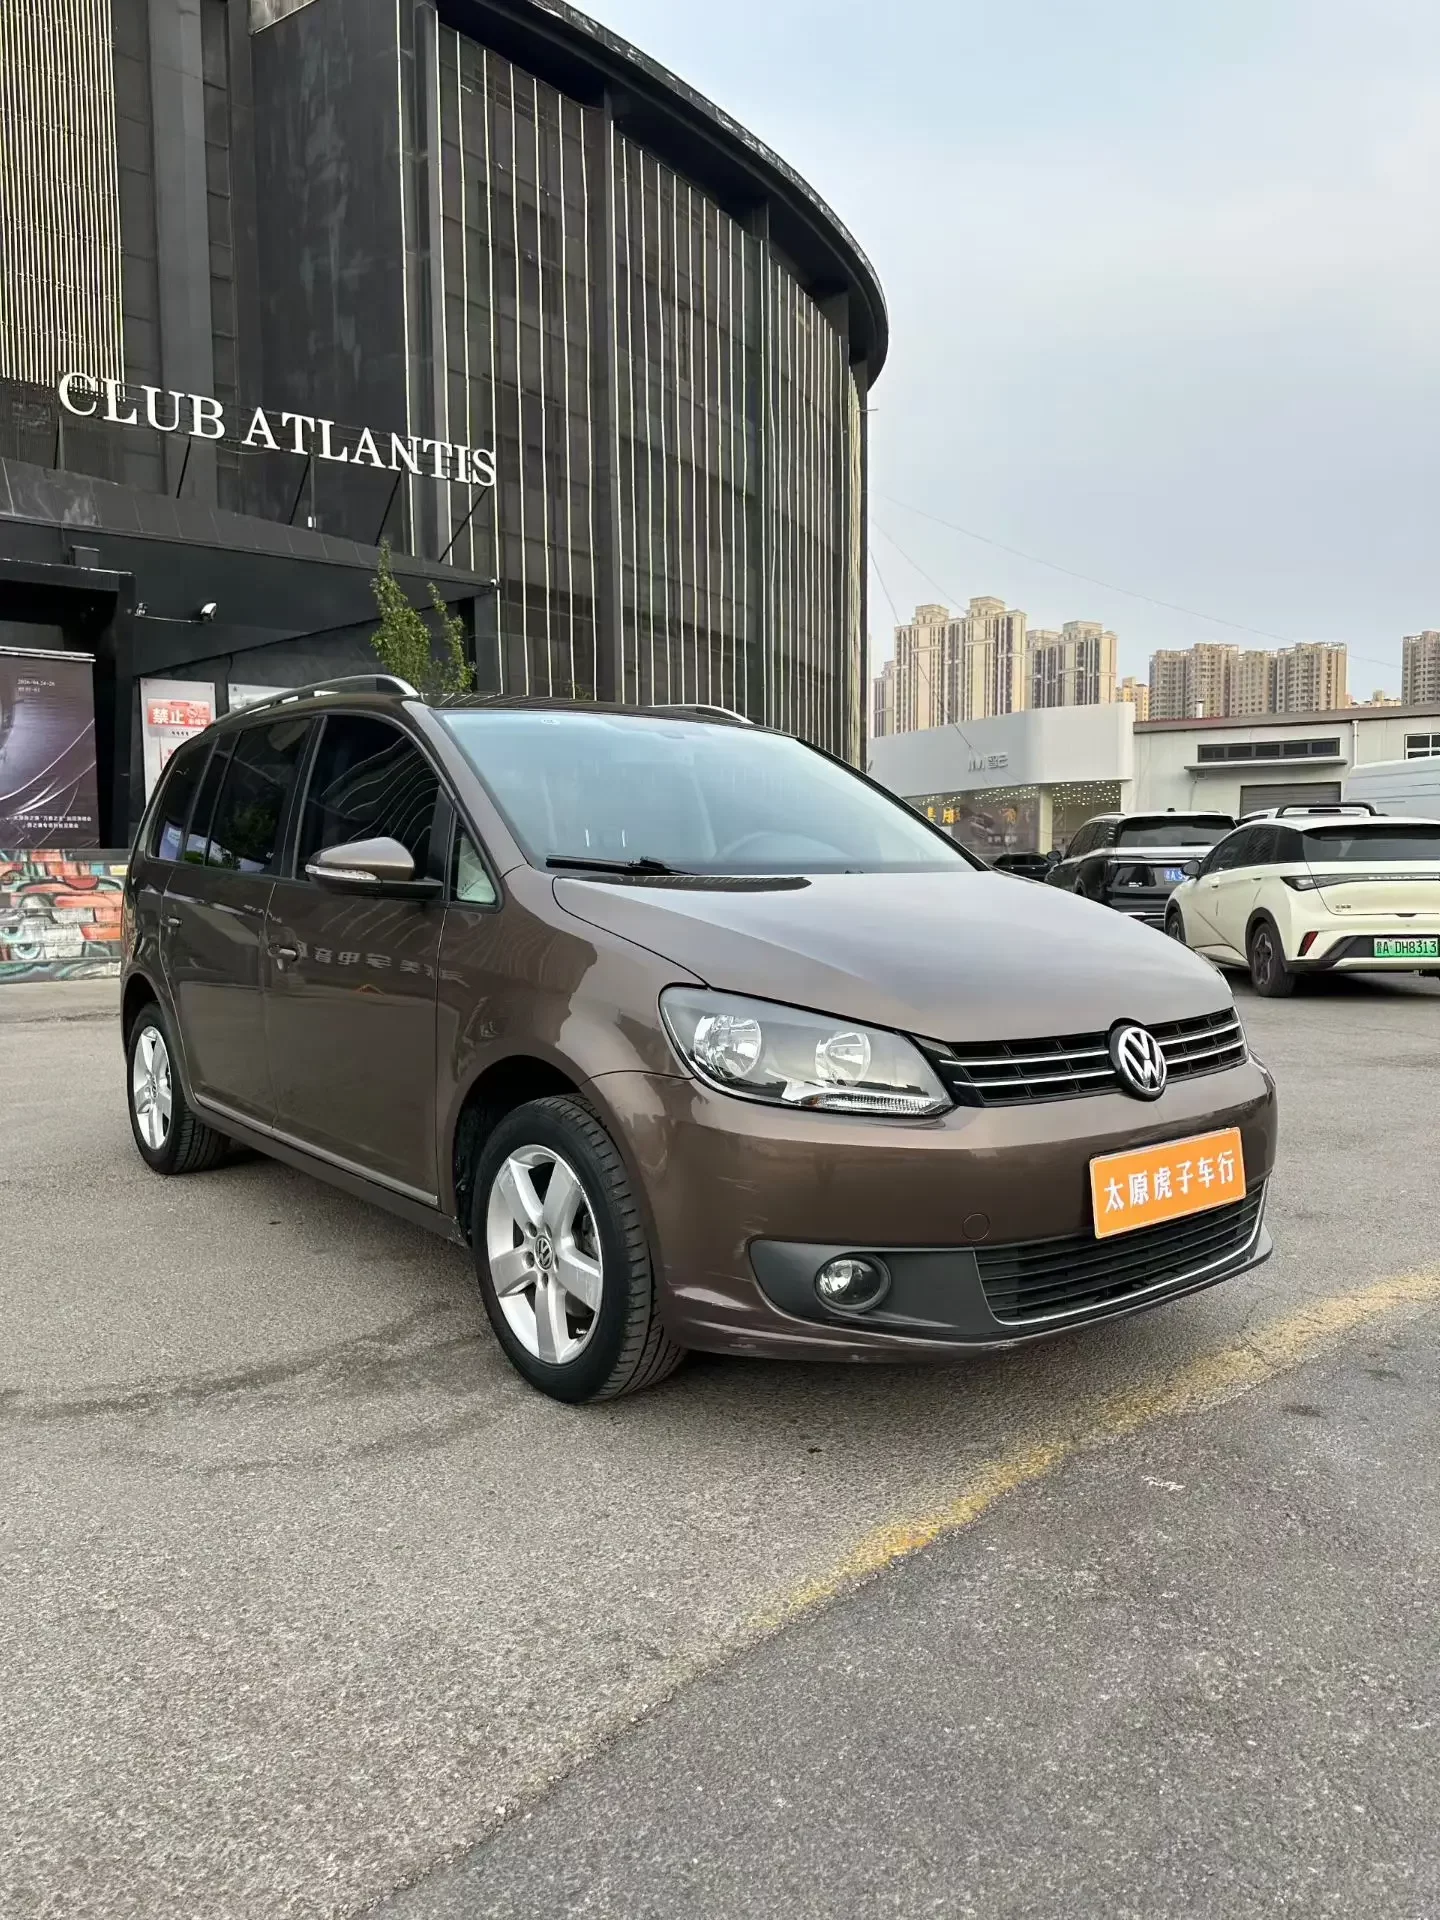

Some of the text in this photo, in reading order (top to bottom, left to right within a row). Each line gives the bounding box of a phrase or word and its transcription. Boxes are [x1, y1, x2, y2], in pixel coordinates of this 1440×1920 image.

[58, 371, 497, 487] CLUB ATLANTIS
[152, 707, 186, 725] 禁止
[1103, 1150, 1236, 1213] 太原虎子车行
